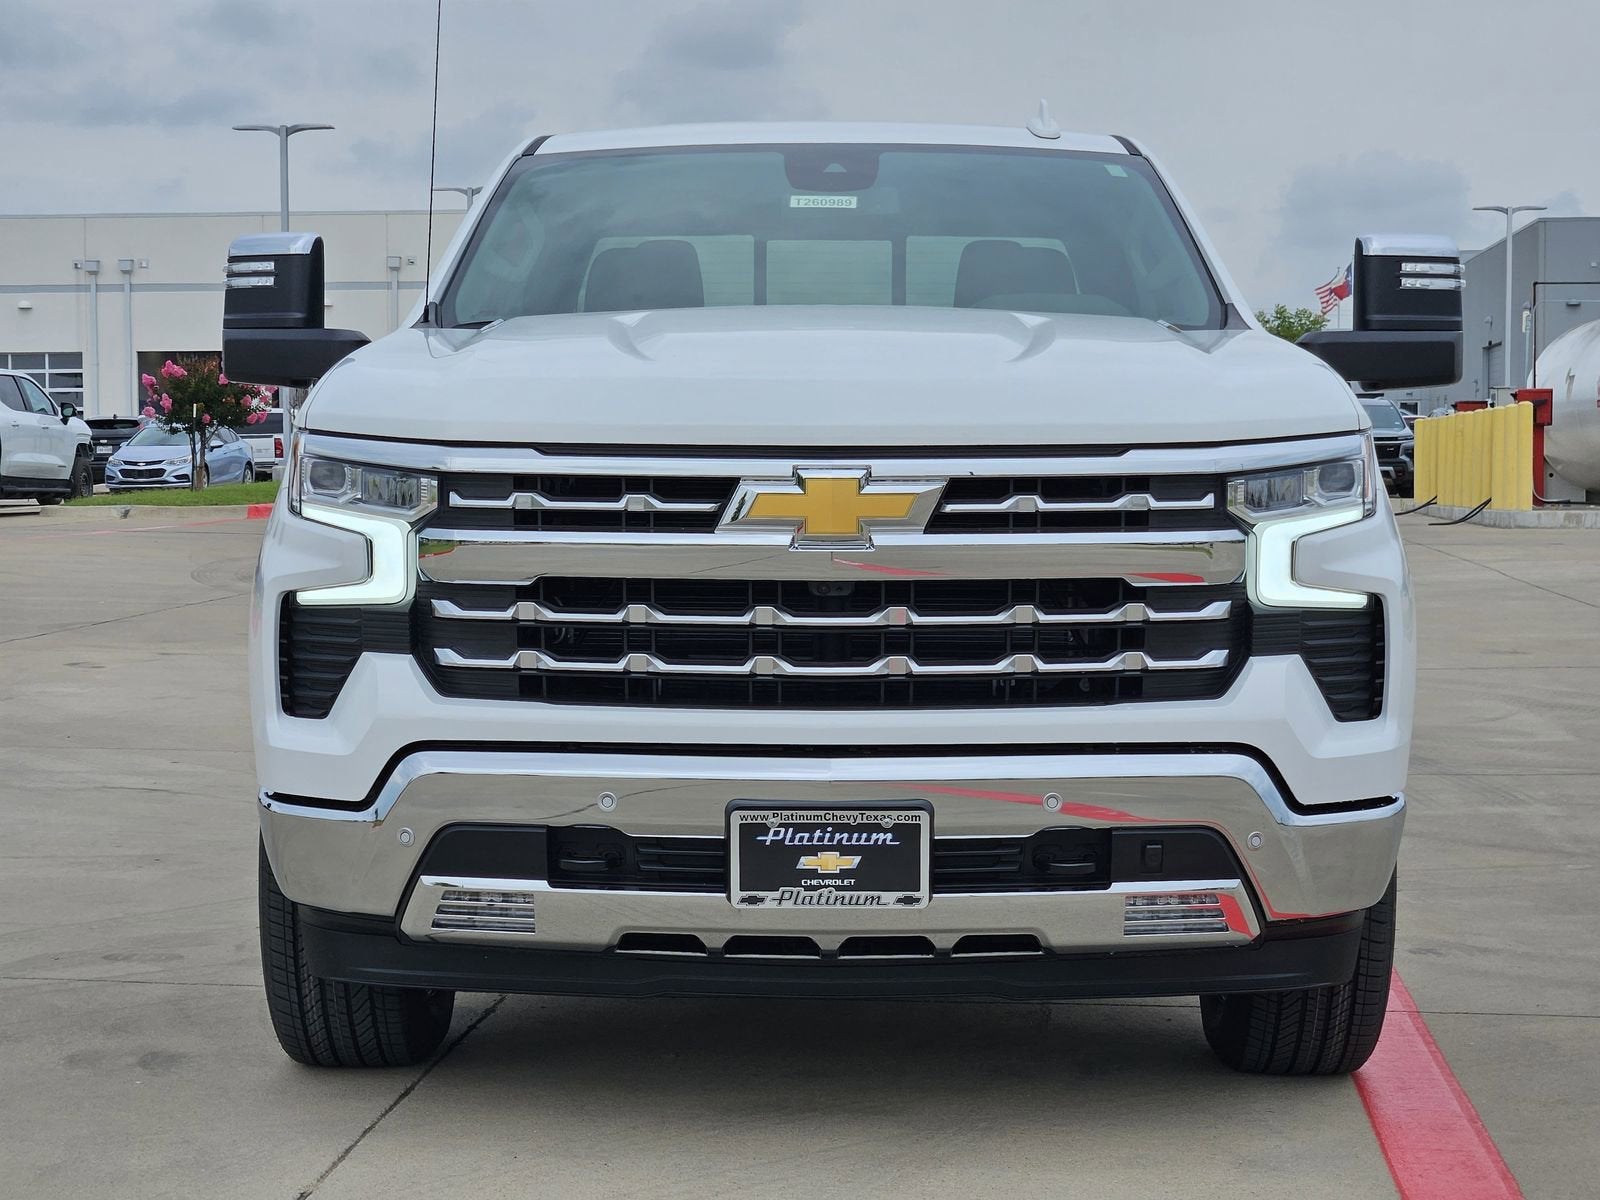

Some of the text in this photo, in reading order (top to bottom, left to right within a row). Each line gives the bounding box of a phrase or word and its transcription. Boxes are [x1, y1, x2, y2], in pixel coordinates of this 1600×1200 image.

[794, 198, 852, 207] T260989
[739, 812, 921, 823] wwwPlatinumChevyTexas.com
[756, 827, 900, 845] Platinum
[771, 889, 889, 907] Platinum
